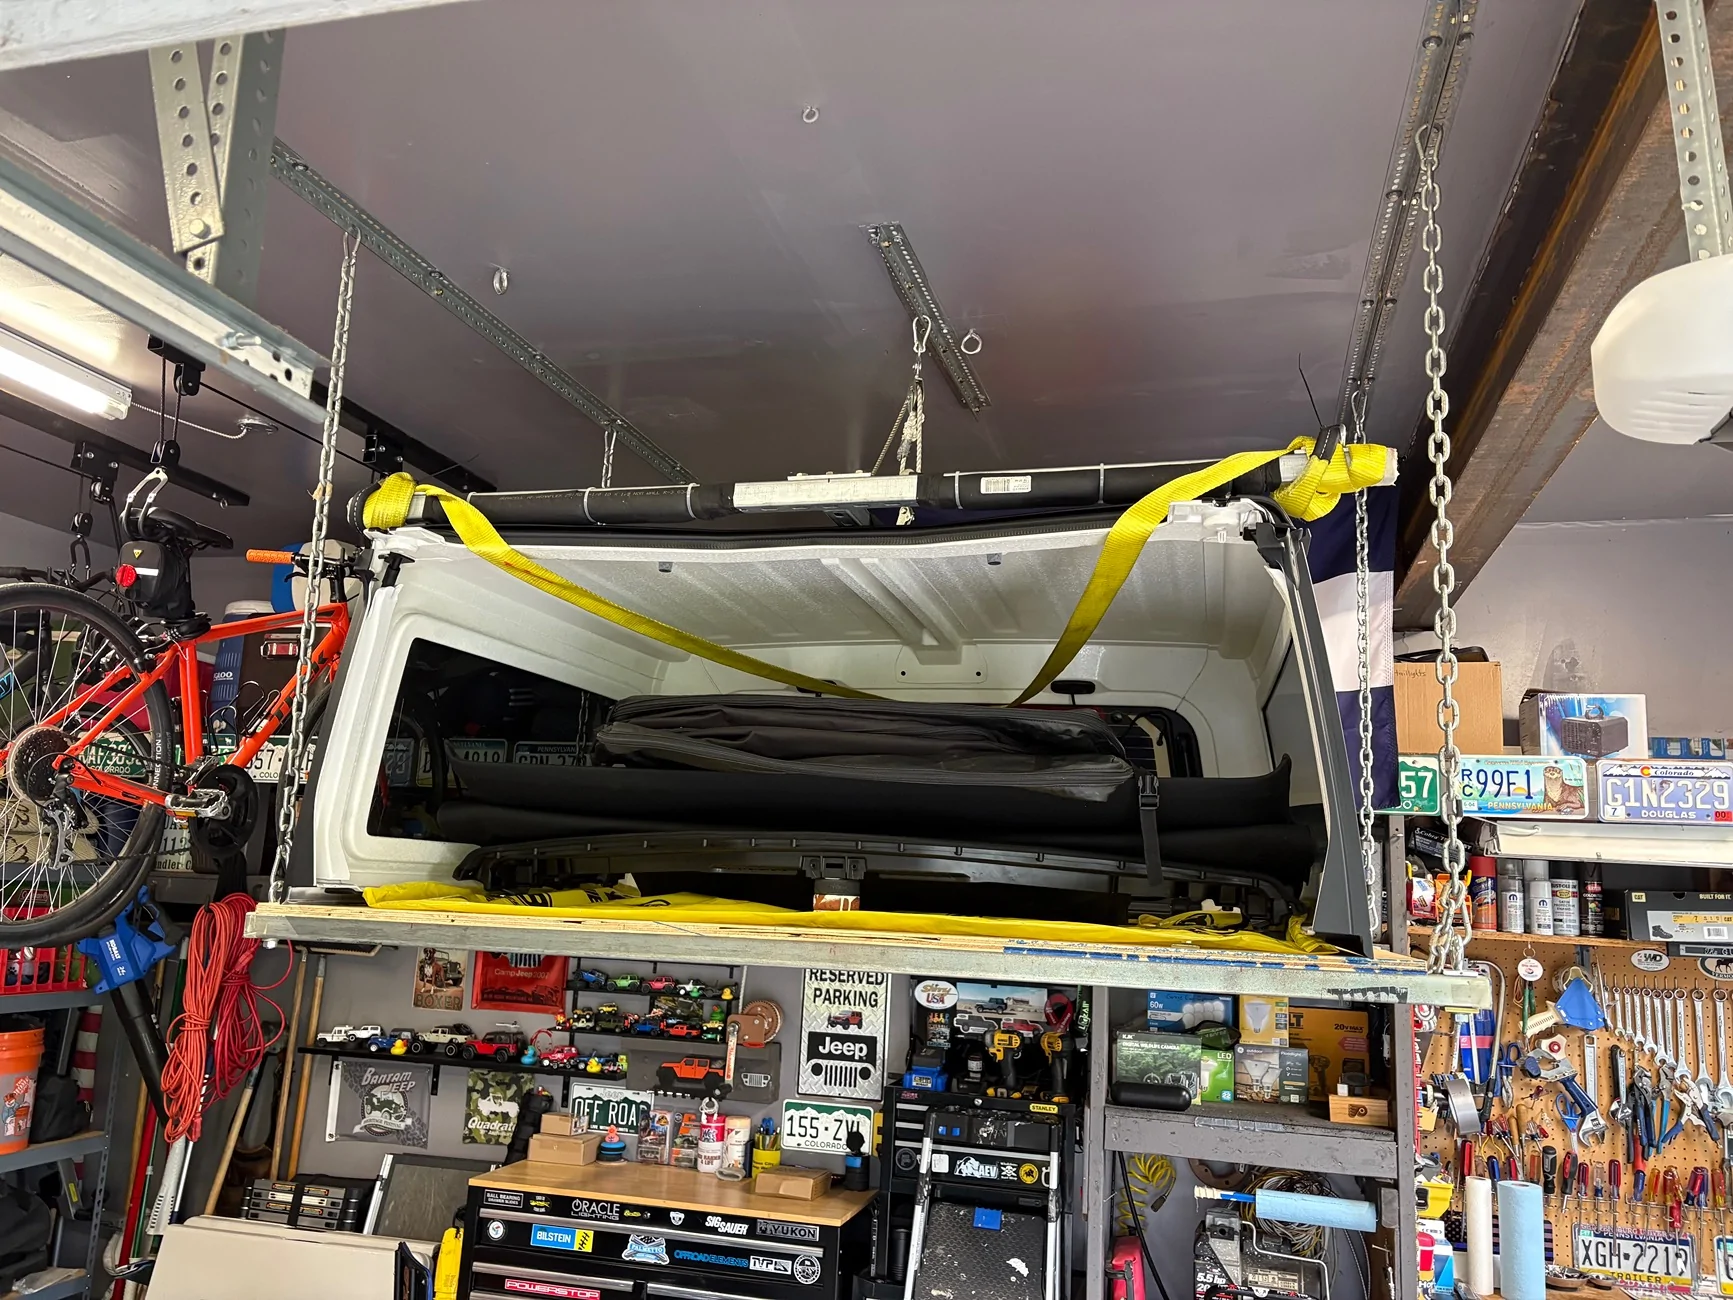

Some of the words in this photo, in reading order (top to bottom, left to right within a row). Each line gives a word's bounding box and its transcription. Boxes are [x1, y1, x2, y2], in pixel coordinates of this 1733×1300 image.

[1606, 778, 1730, 810] G1N2329
[1487, 801, 1554, 811] PENNSYLVANIA
[1611, 808, 1617, 816] 7
[1641, 810, 1697, 819] DOUGLAS
[494, 968, 516, 977] Camp
[516, 969, 533, 979] Jeep
[533, 972, 549, 980] 2007
[809, 969, 885, 986] RESERVED
[416, 993, 461, 1010] BOXER
[813, 988, 879, 1008] PARKING
[926, 993, 945, 1004] USA
[818, 1036, 868, 1060] Jeep
[386, 1080, 417, 1095] JEEP
[574, 1098, 604, 1123] OFF
[1032, 1104, 1056, 1112] STANLEY
[804, 1139, 848, 1151] COLORADO
[978, 1165, 998, 1177] AEV
[571, 1198, 621, 1216] ORACLE
[571, 1211, 620, 1221] LIGHTING
[705, 1215, 721, 1228] SIG
[717, 1222, 750, 1236] SAUER
[771, 1225, 816, 1239] YUKON
[536, 1230, 572, 1243] BILSTEIN
[1196, 1273, 1214, 1283] 5.5
[1213, 1274, 1226, 1285] hp
[1609, 1271, 1662, 1284] TRAILER
[505, 1280, 599, 1299] POWERSTOP
